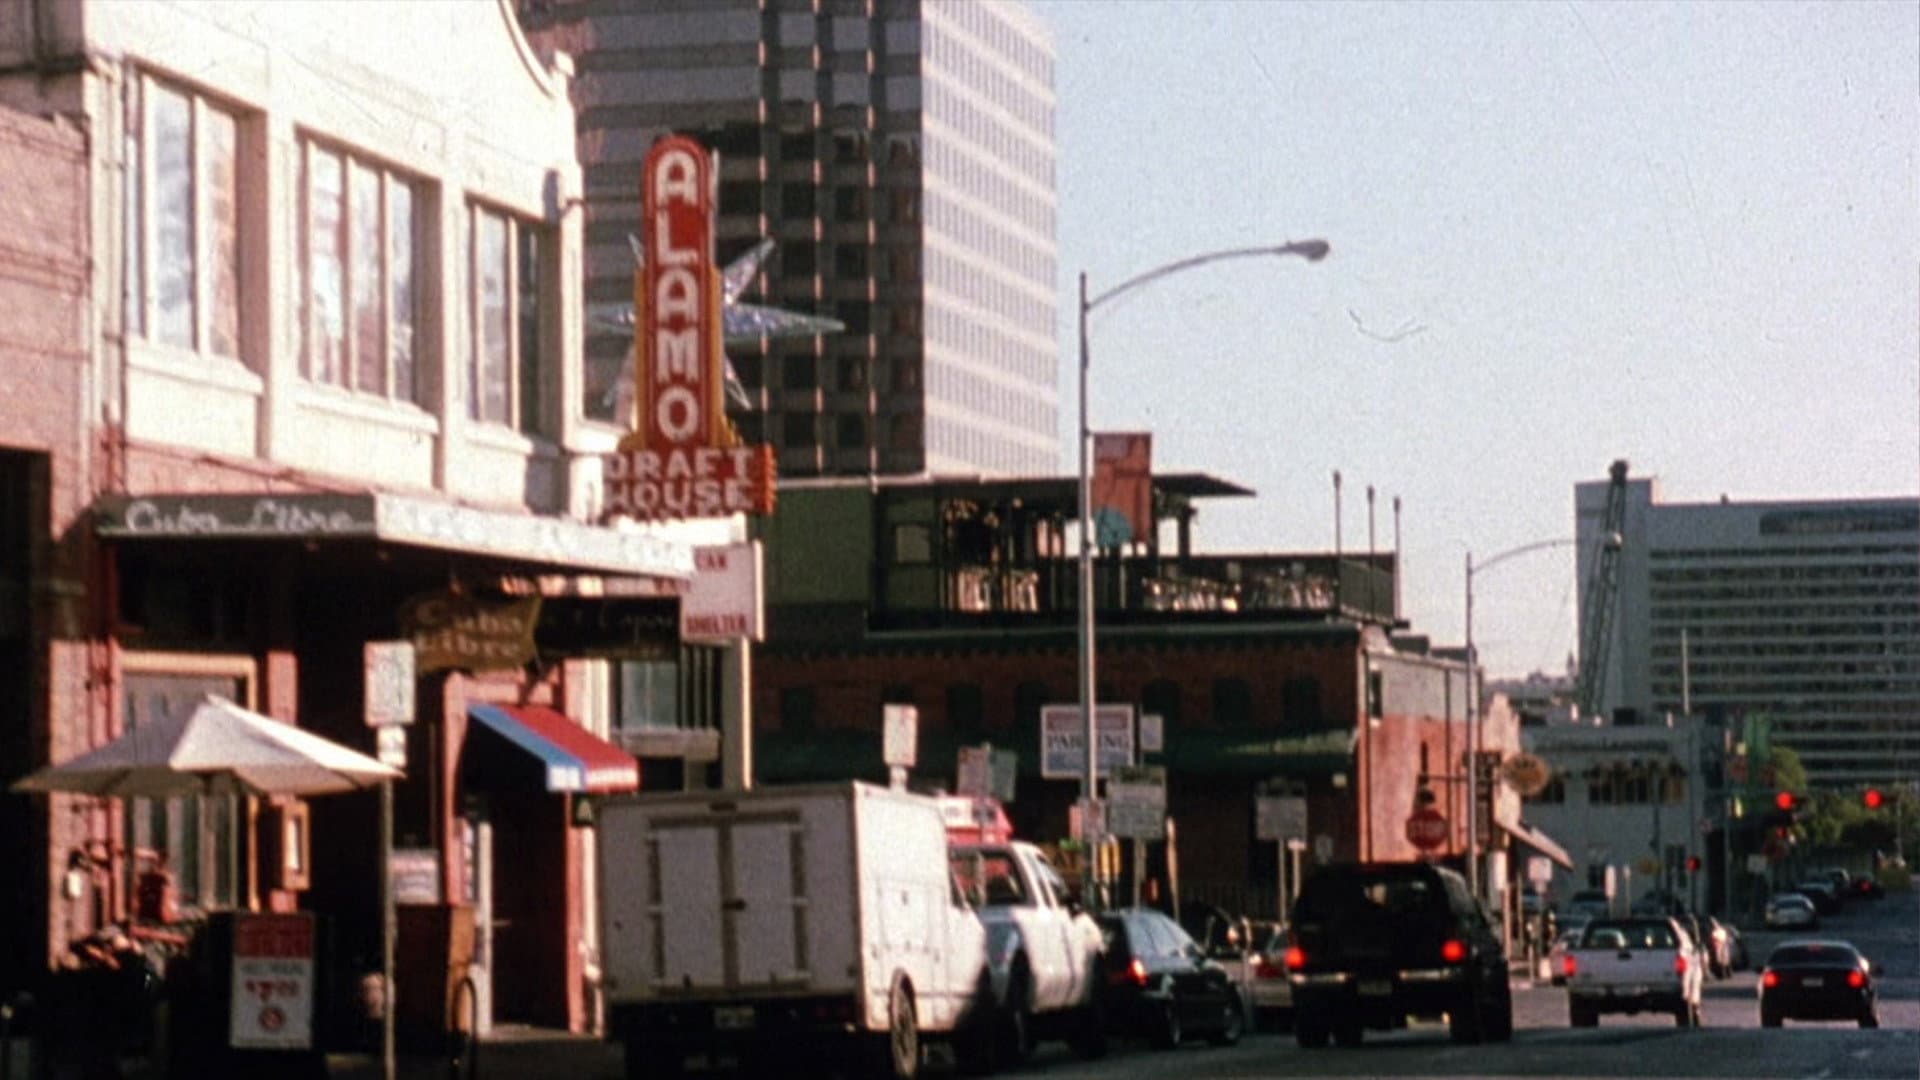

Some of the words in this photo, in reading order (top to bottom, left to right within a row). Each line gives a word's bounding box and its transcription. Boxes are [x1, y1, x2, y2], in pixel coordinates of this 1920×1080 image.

[655, 150, 699, 442] ALAMO
[602, 447, 754, 480] DRAFT
[602, 479, 754, 510] HOUSE
[125, 500, 220, 532] Cuba
[1046, 734, 1131, 751] PARING
